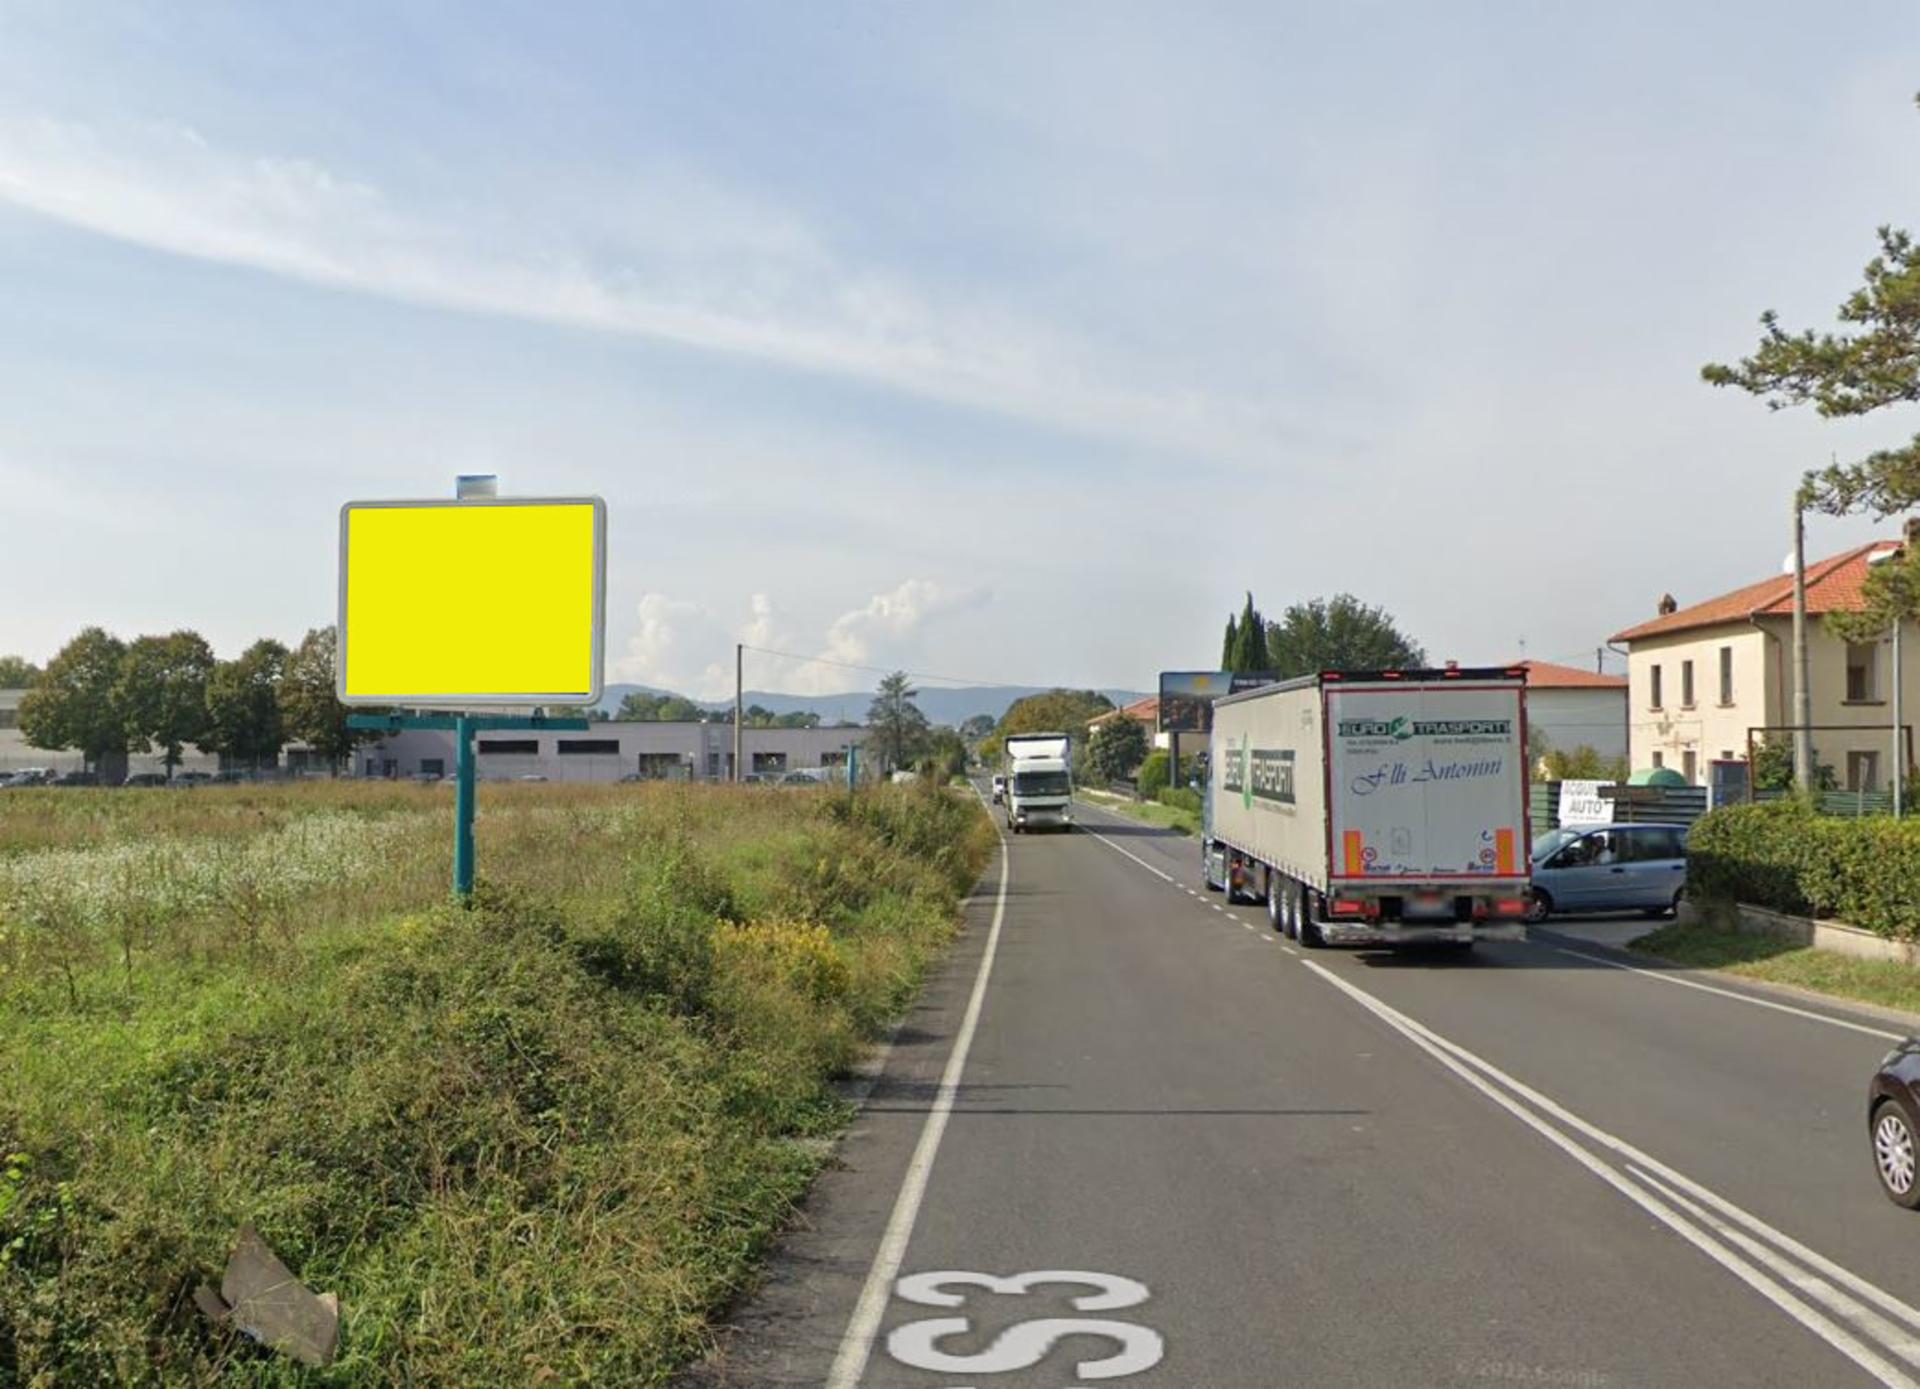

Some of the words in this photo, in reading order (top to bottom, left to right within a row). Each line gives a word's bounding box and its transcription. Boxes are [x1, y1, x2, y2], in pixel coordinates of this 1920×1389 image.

[1341, 722, 1389, 736] EURO
[1414, 720, 1510, 735] TRASPORTI
[1568, 800, 1602, 814] AUTO
